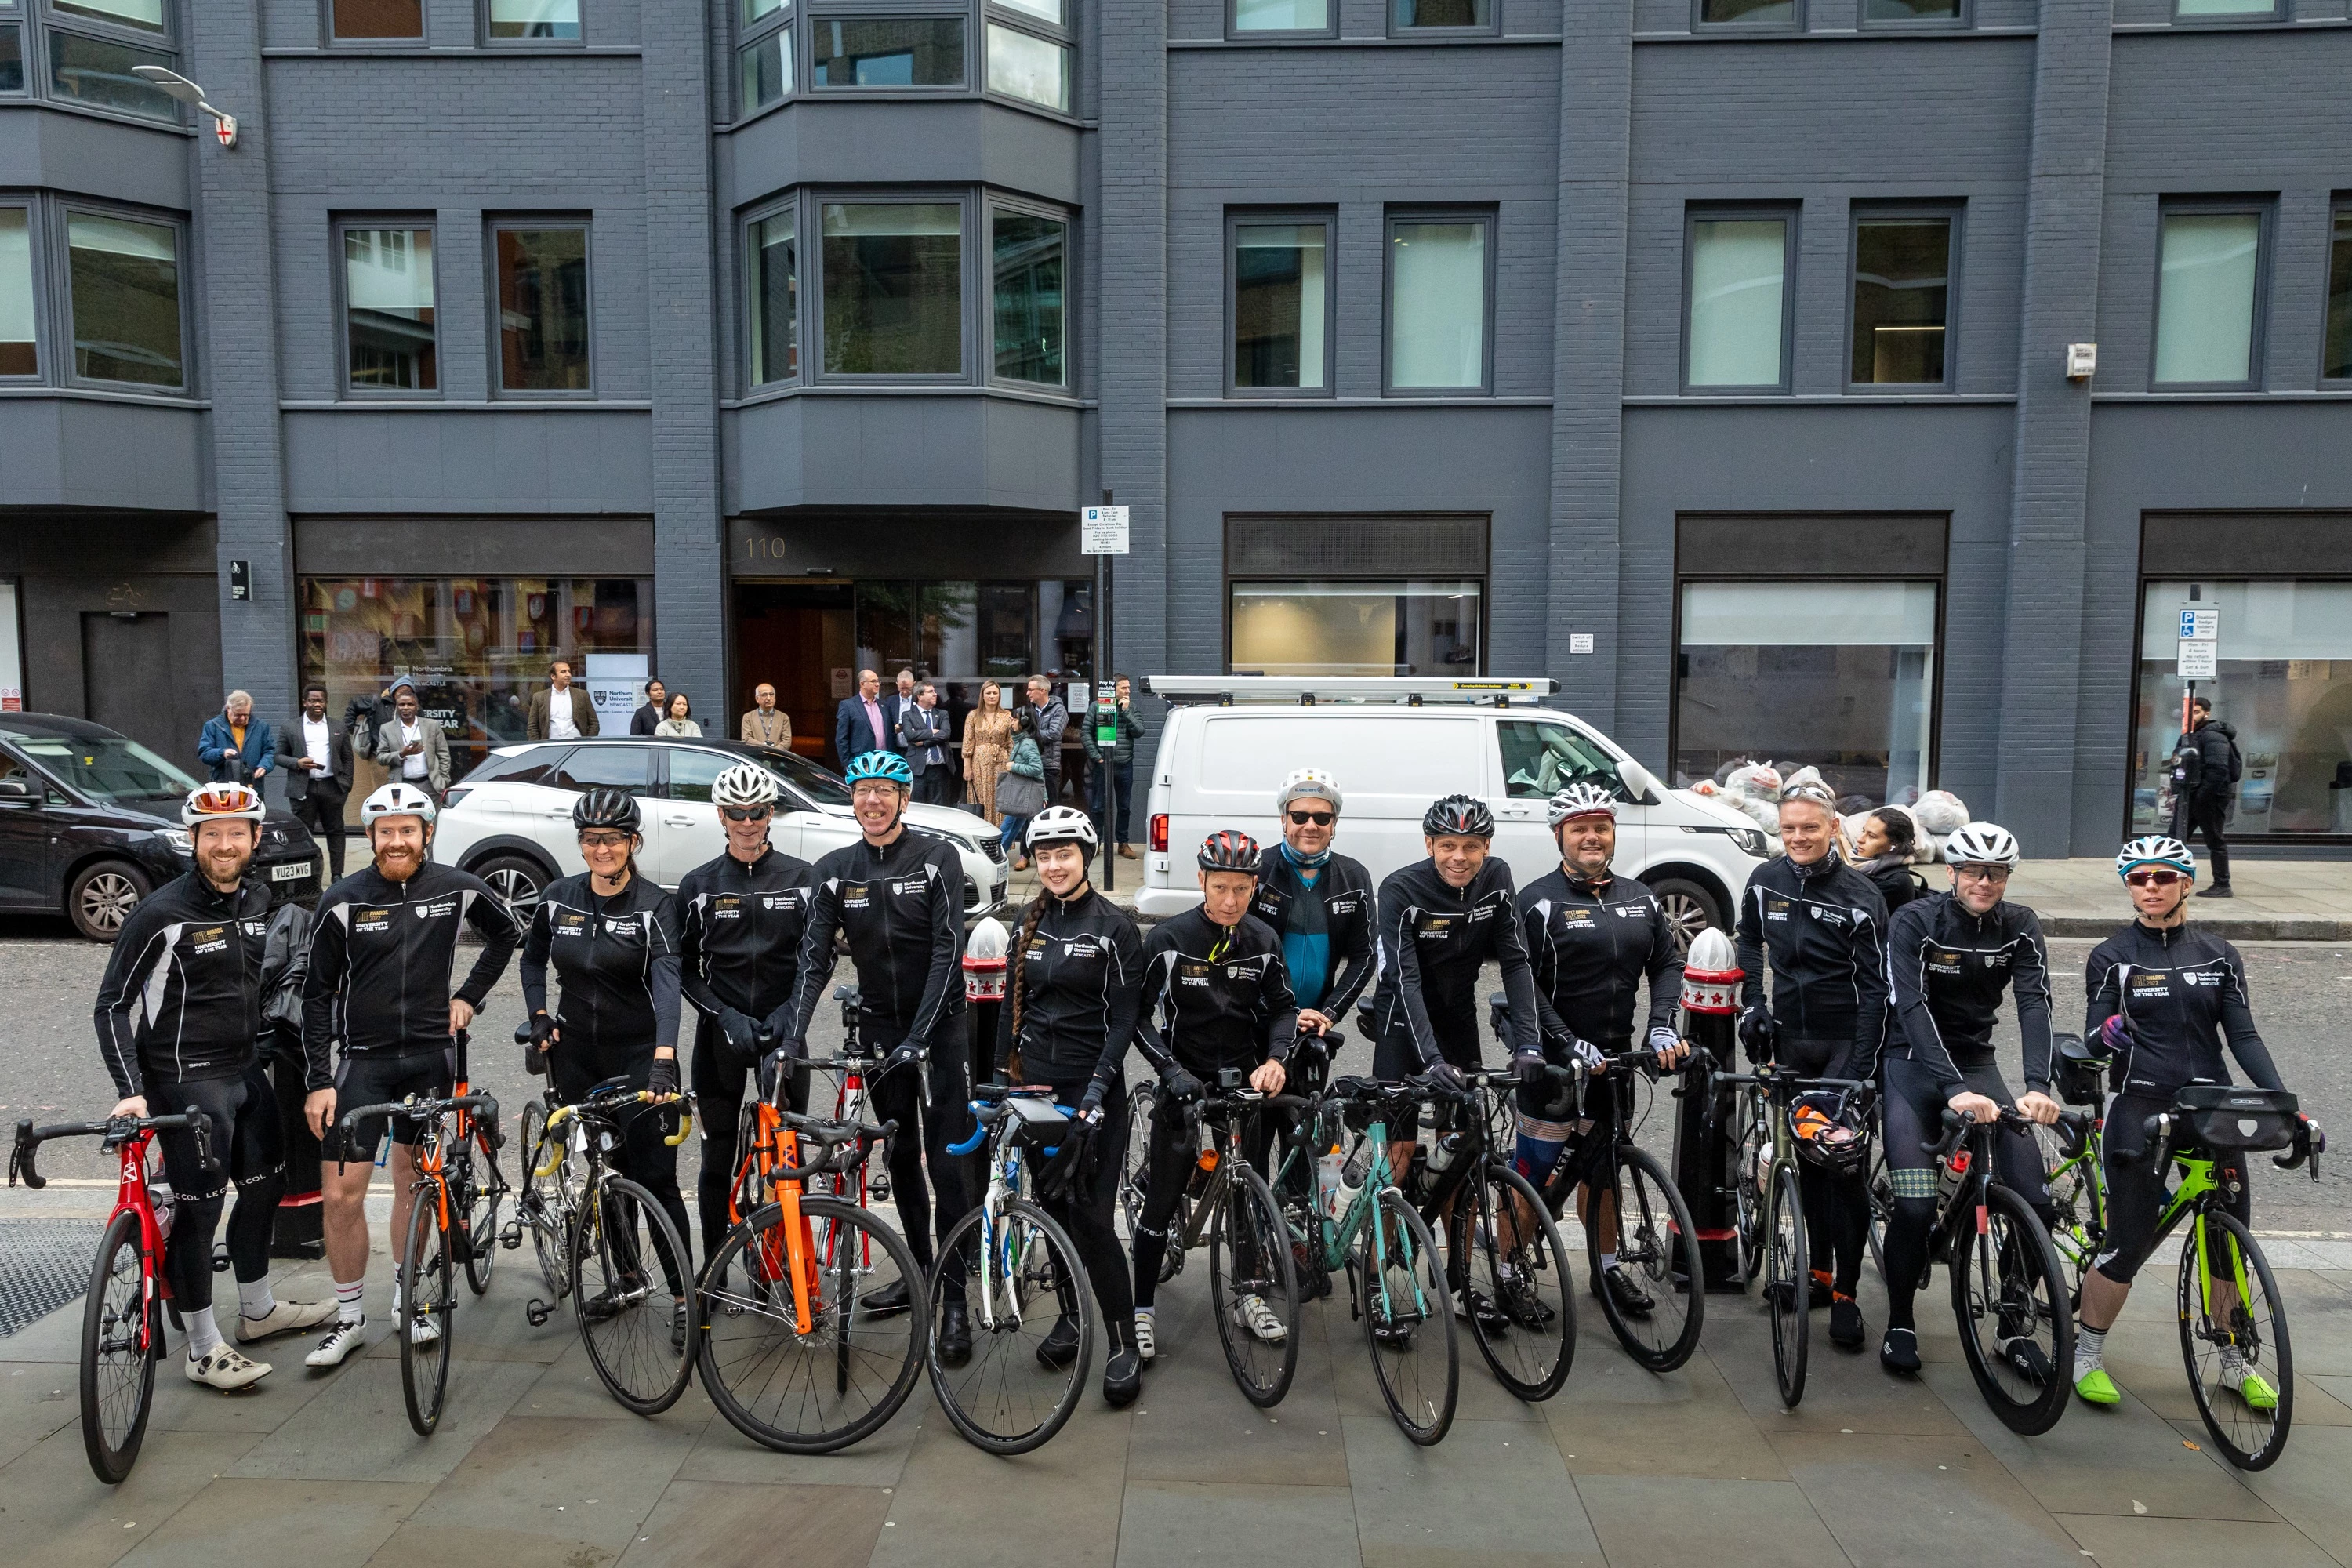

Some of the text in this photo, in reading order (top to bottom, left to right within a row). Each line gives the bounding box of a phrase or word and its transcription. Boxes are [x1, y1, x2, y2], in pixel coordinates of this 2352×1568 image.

[746, 537, 785, 557] 110
[2184, 613, 2193, 623] P
[423, 710, 456, 718] ERSITY
[440, 720, 459, 728] EAR
[276, 864, 308, 878] VU23 MVG
[206, 927, 223, 936] AWARDS
[194, 939, 226, 950] UNIVERSITY
[274, 1163, 283, 1174] LE
[245, 1174, 266, 1185] COL
[206, 1190, 219, 1199] LE
